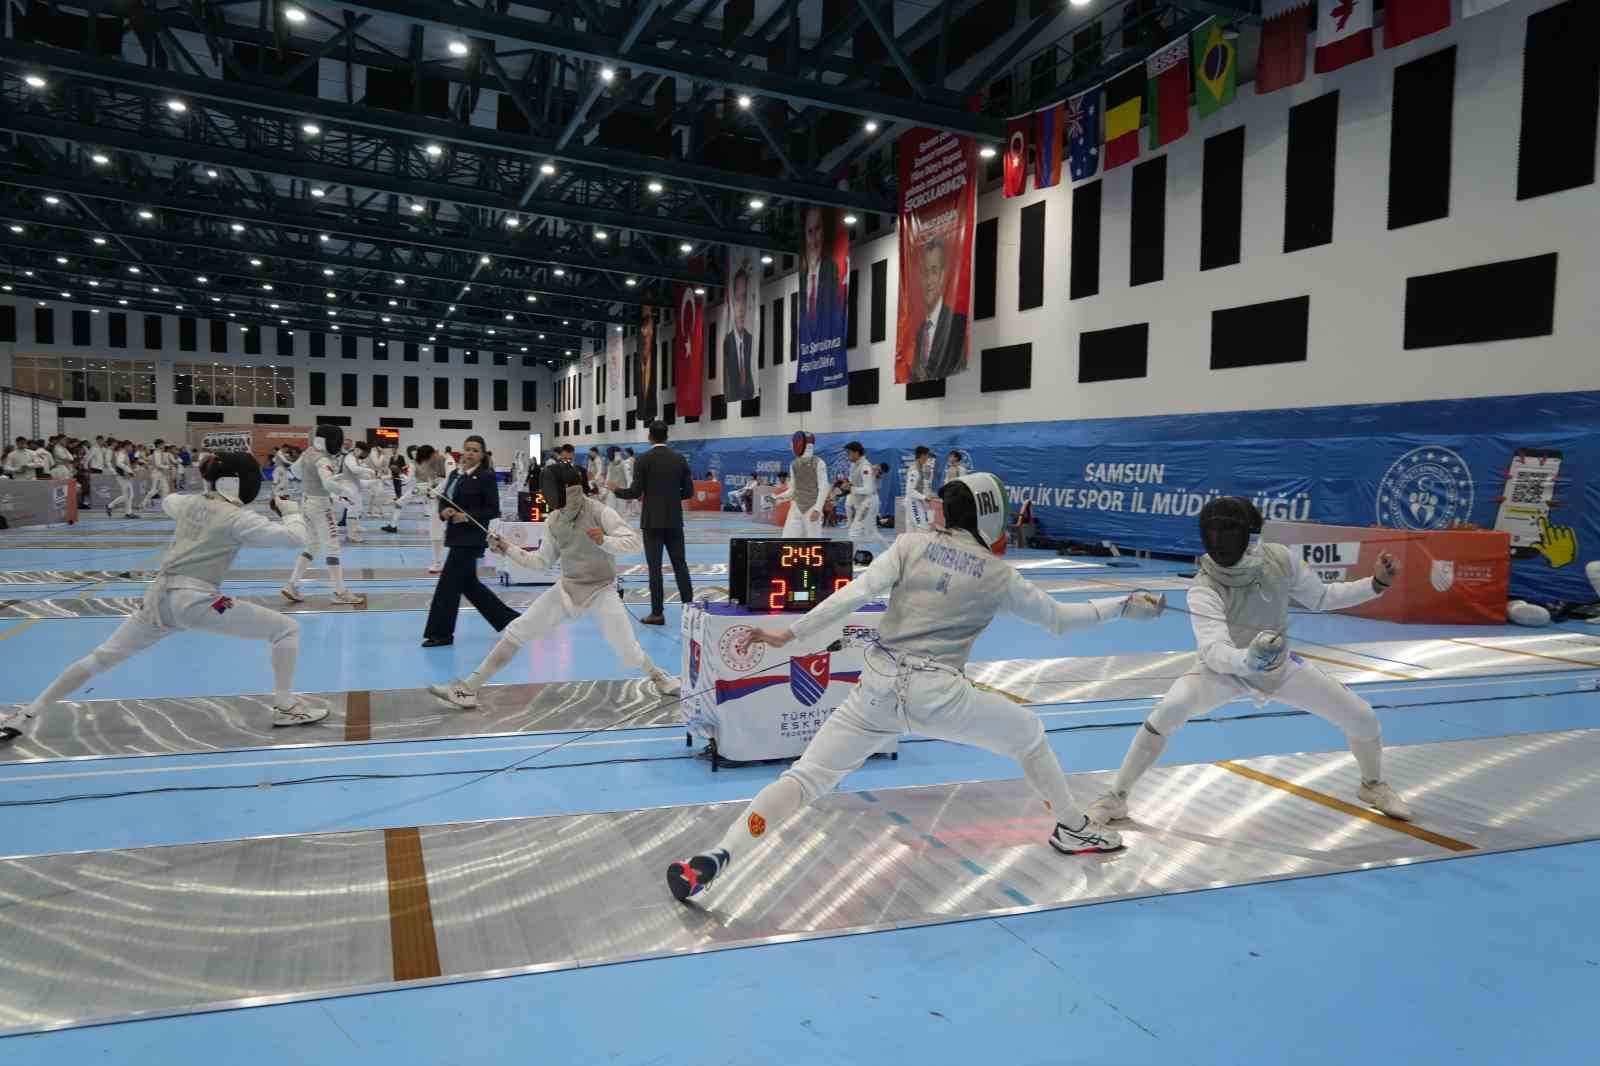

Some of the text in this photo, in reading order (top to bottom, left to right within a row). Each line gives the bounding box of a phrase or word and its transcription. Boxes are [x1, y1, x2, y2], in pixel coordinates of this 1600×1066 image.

[1084, 463, 1165, 484] SAMSUN
[976, 490, 1000, 516] IRL
[1055, 488, 1074, 507] VE
[1077, 488, 1124, 513] SPOR
[1131, 486, 1146, 513] İL
[781, 545, 823, 567] 2:45
[1303, 543, 1341, 563] FOIL
[769, 579, 786, 609] 2
